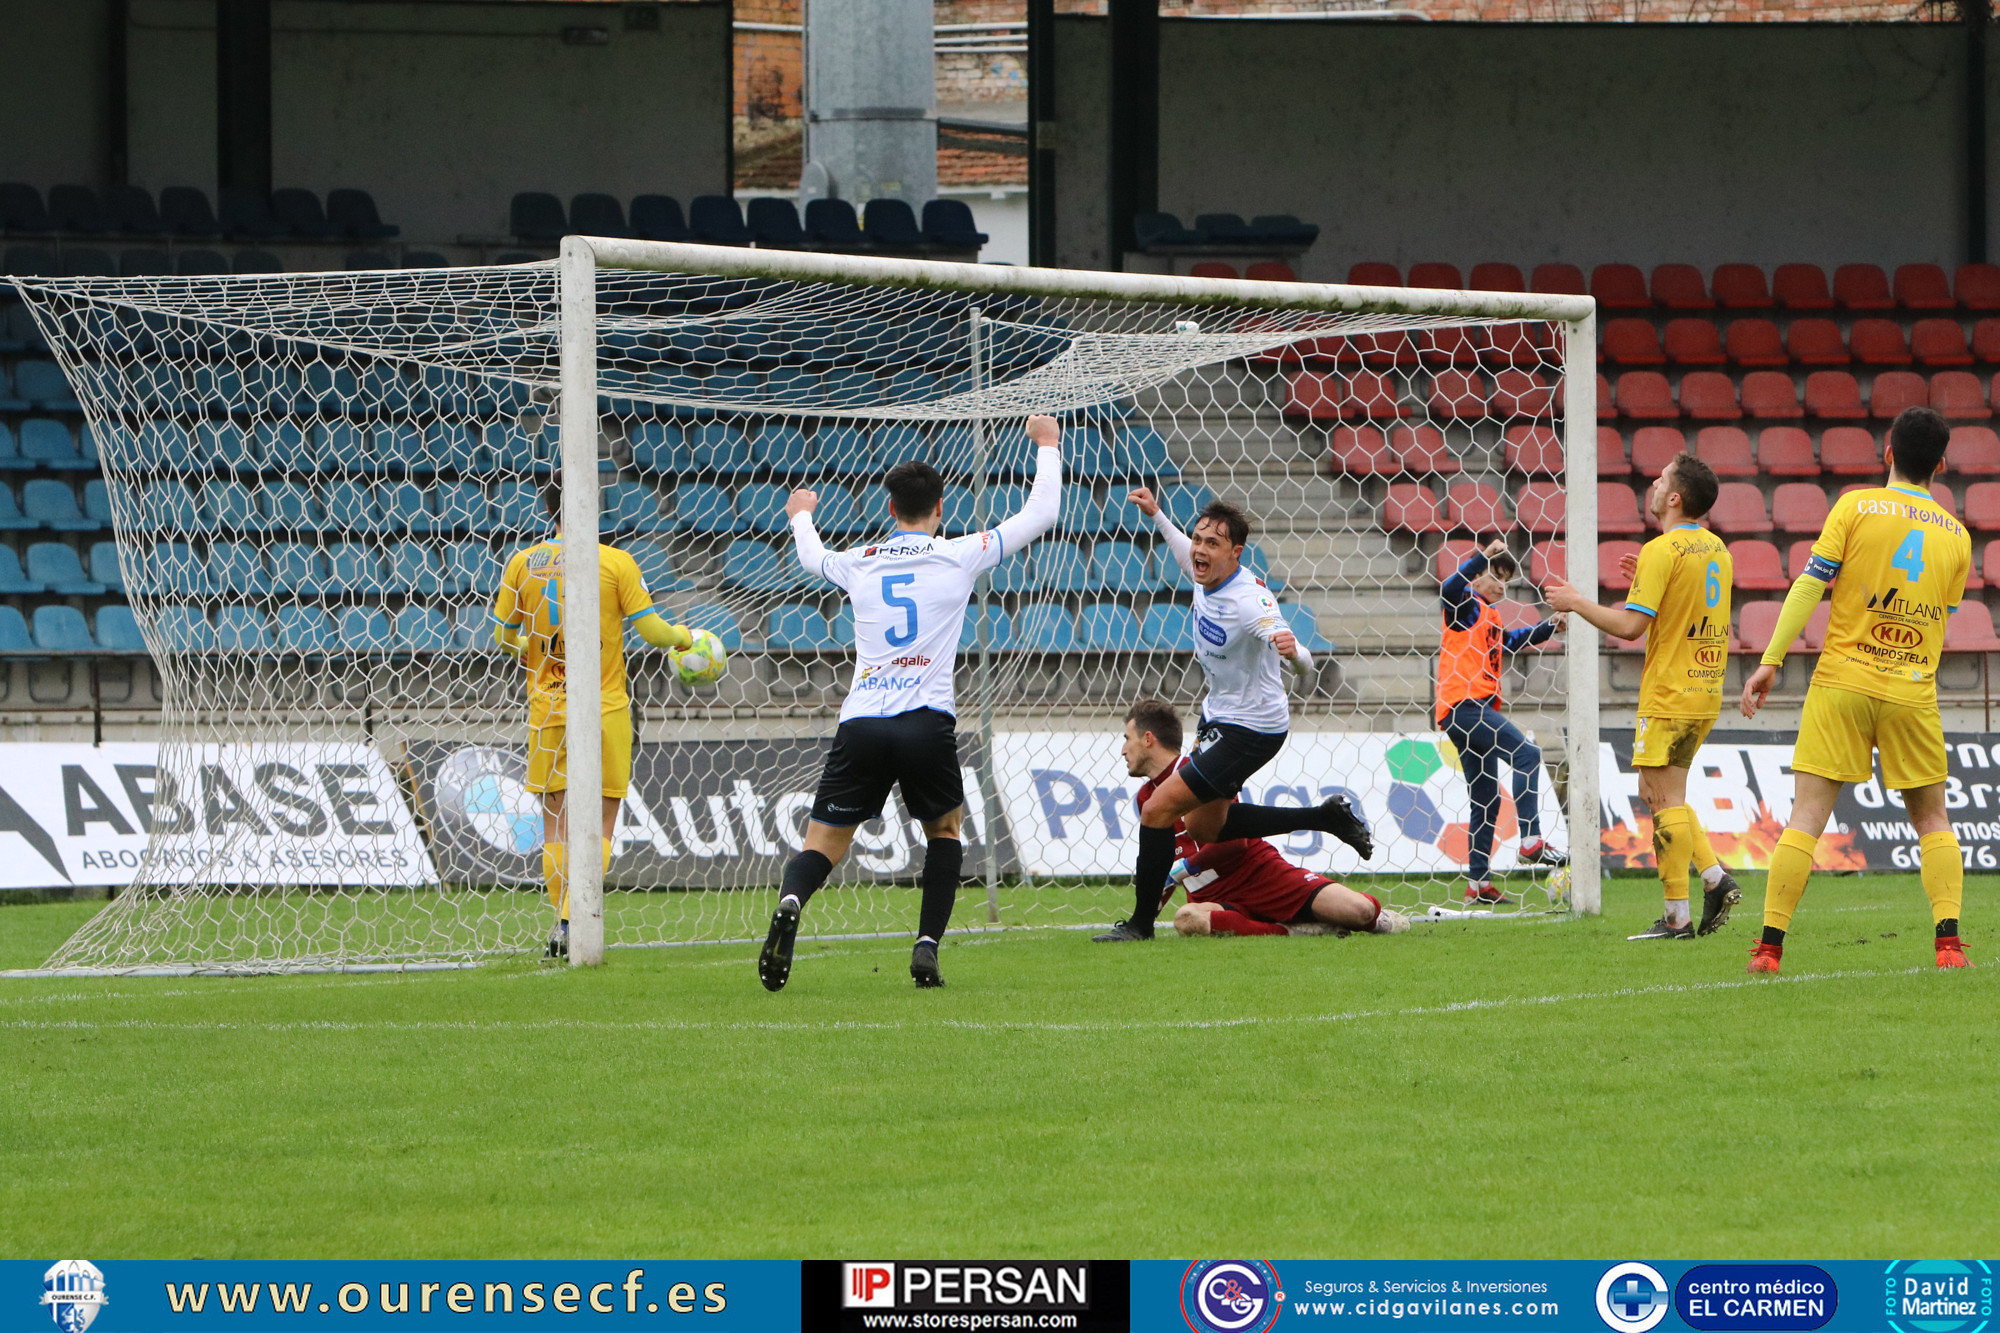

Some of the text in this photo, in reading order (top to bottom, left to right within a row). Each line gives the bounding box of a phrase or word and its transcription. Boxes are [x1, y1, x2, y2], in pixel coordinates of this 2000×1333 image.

[1891, 529, 1925, 582] 4
[1706, 561, 1720, 608] 6
[881, 573, 917, 648] 5
[1879, 625, 1914, 645] KIA
[1857, 642, 1928, 665] COMPOSTELA
[857, 675, 921, 691] ABANCA
[61, 763, 396, 837] ABASE
[82, 850, 235, 869] ABOGADOS
[271, 849, 408, 868] ASESORES
